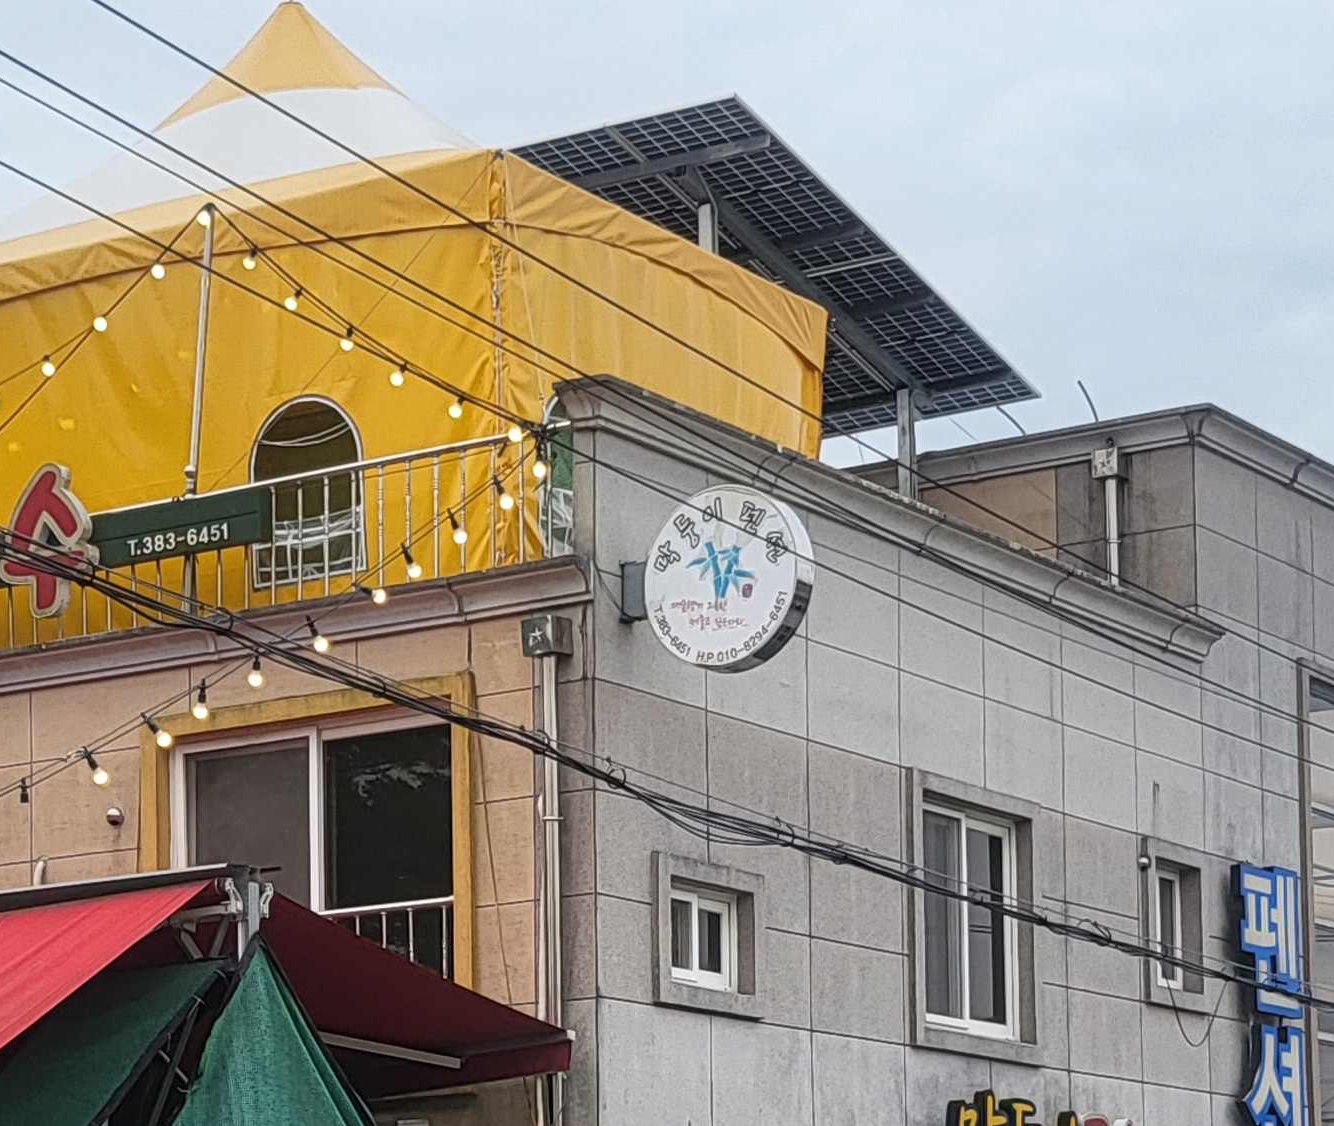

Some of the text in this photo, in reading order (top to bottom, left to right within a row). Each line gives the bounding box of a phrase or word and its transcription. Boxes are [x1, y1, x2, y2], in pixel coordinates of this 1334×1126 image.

[127, 522, 229, 557] T.383-6451
[653, 590, 788, 662] T.383-6451 H.P 010-8294-6451
